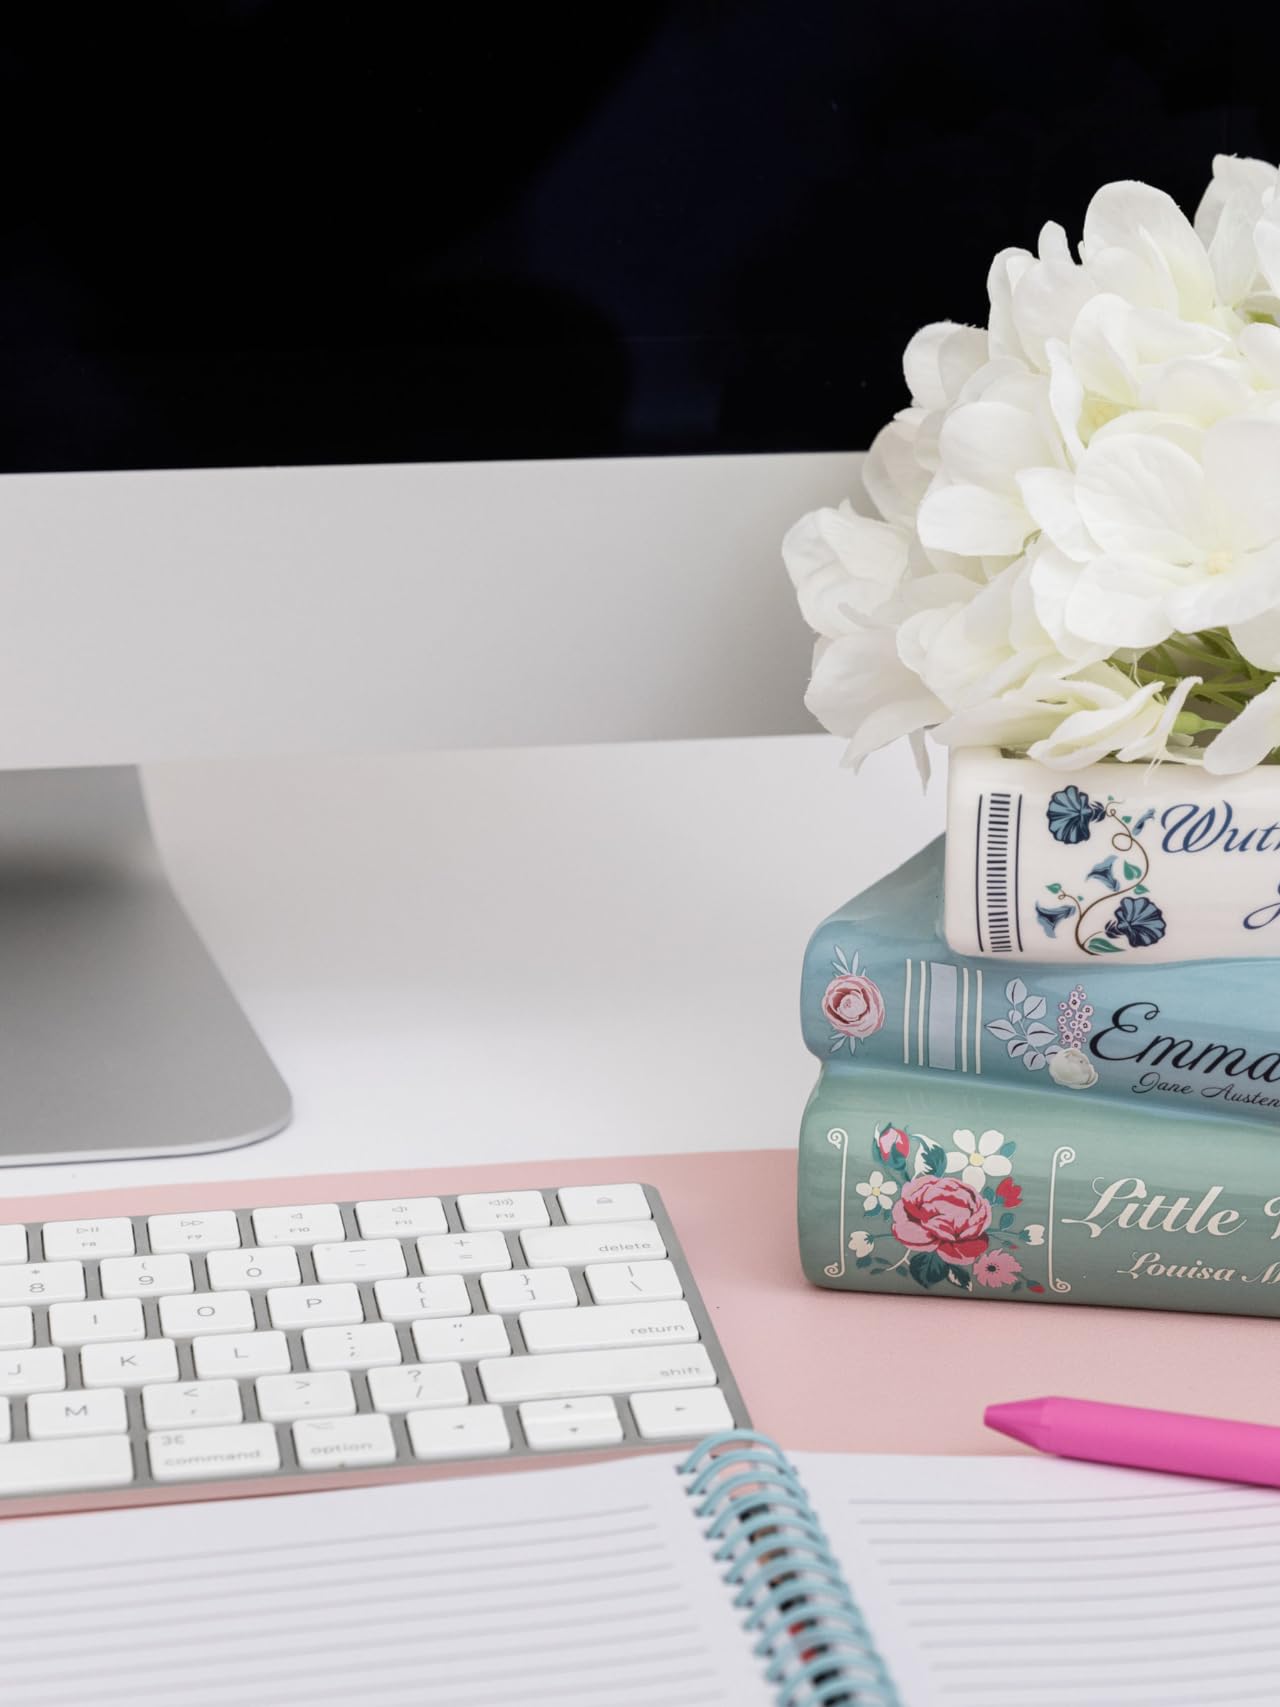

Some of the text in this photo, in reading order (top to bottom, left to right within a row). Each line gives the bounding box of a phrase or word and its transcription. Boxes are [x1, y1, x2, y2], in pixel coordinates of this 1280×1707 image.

[1131, 1071, 1193, 1095] Jane
[1061, 1176, 1247, 1239] Little
[598, 1240, 652, 1252] delete
[1116, 1250, 1246, 1282] Louisa
[138, 1275, 155, 1286] 9
[29, 1282, 46, 1293] 8
[306, 1298, 323, 1309] P
[196, 1306, 216, 1318] O
[630, 1323, 685, 1336] return
[233, 1348, 249, 1360] L
[119, 1355, 138, 1367] K
[7, 1363, 22, 1376] J
[659, 1366, 701, 1377] shift
[64, 1405, 89, 1418] M
[309, 1442, 374, 1456] option
[163, 1449, 262, 1467] command
